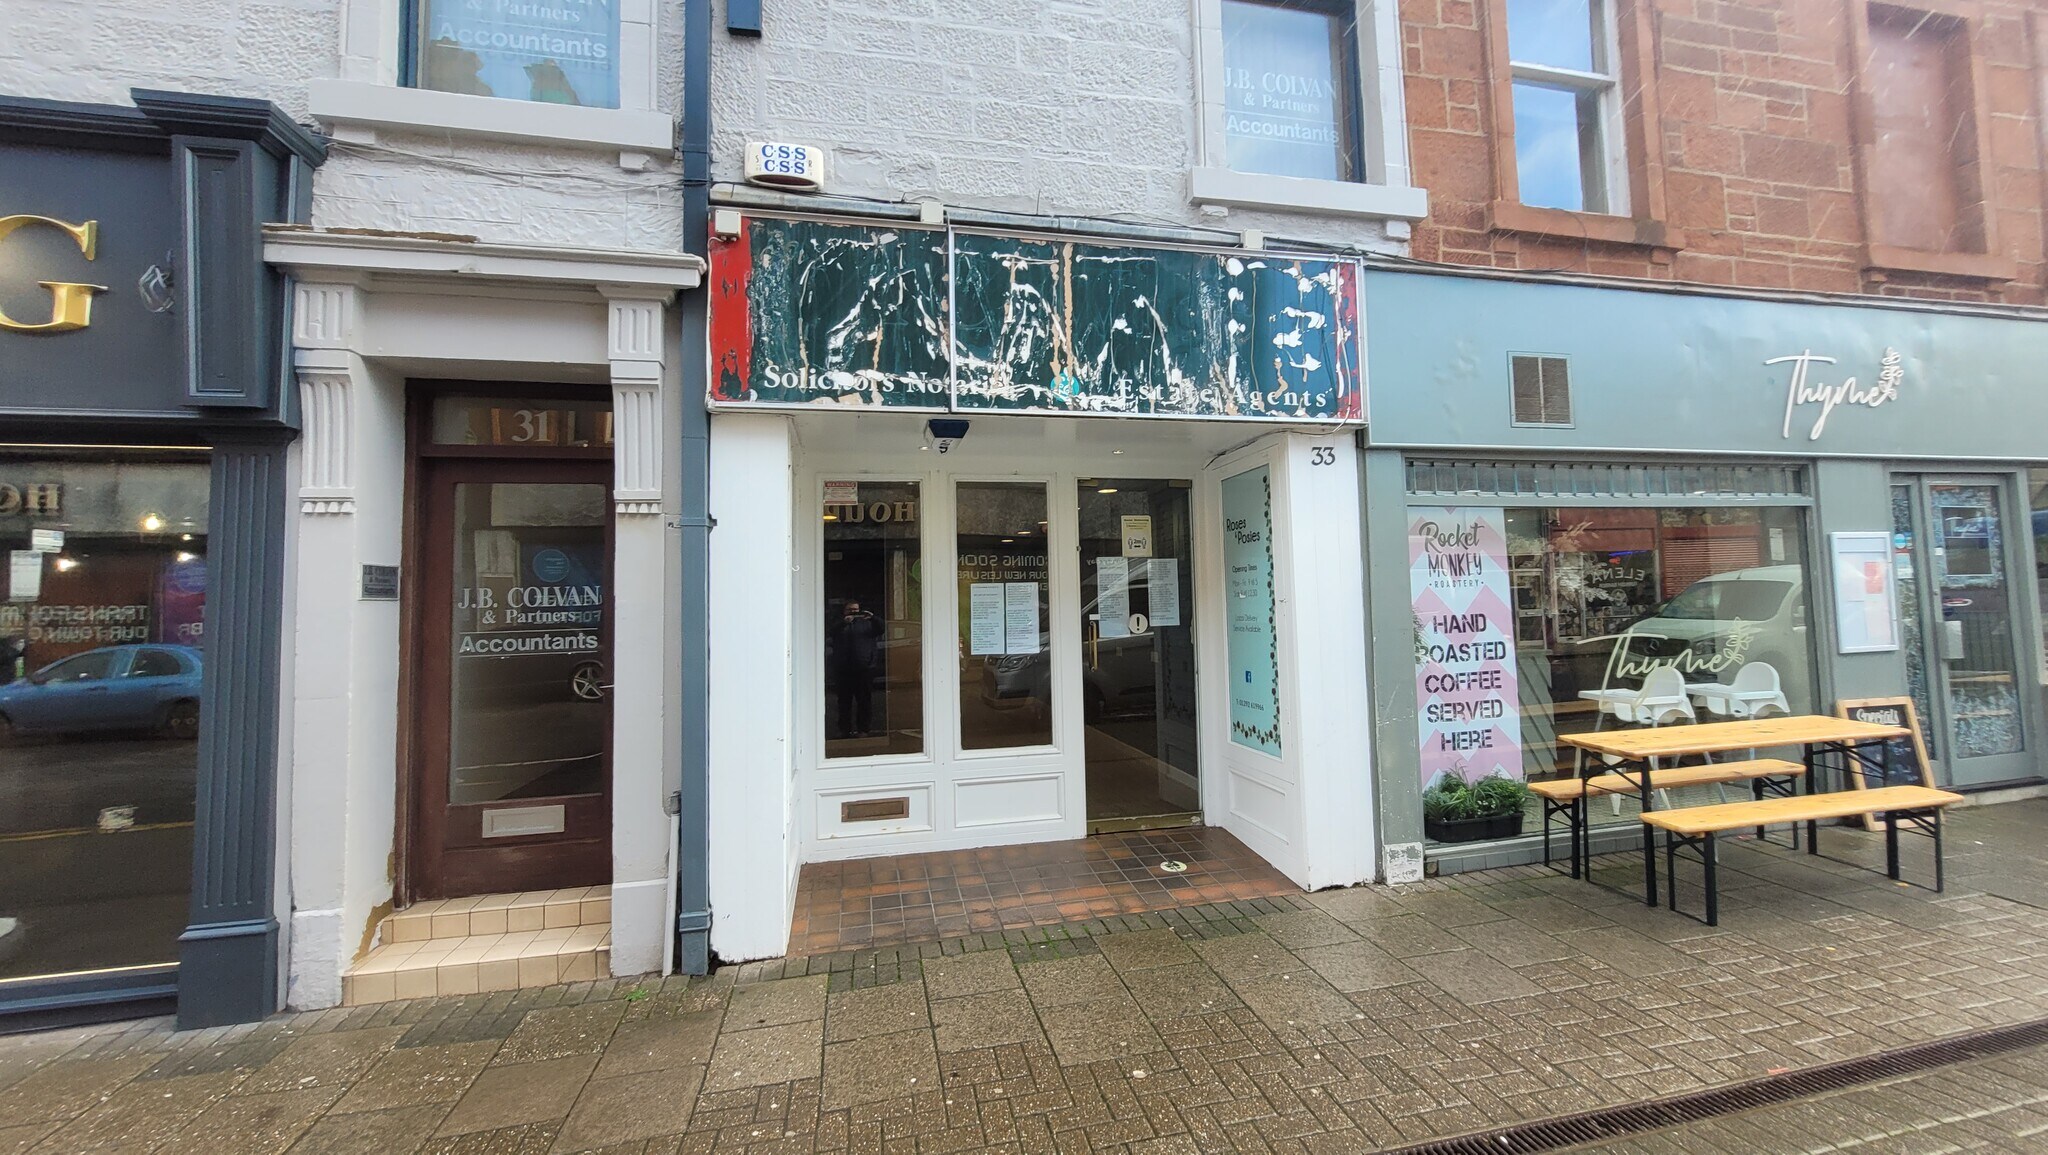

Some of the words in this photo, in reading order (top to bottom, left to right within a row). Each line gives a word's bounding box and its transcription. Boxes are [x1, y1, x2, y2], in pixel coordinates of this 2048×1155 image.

[497, 0, 581, 22] Partners
[432, 22, 607, 59] Accountants
[1224, 67, 1255, 90] J.B.
[1262, 72, 1337, 100] COLVAN
[1244, 92, 1255, 106] &
[1262, 94, 1320, 114] Partners
[1226, 114, 1340, 143] Accountants
[0, 213, 109, 334] G
[764, 365, 895, 392] Solicors
[1232, 383, 1327, 410] Agents
[1763, 349, 1890, 440] Thyme
[511, 410, 551, 442] 31
[1311, 446, 1336, 466] 33
[1226, 519, 1247, 532] Roses
[1419, 521, 1485, 553] Rocket
[1238, 531, 1260, 545] Posies
[1428, 552, 1482, 578] MONKEY
[1434, 580, 1479, 588] ROASTERY
[458, 588, 498, 608] J.B.
[507, 585, 601, 608] COLVAN
[482, 610, 497, 624] &
[505, 609, 576, 624] Partners
[1432, 613, 1486, 634] HAND
[459, 632, 599, 654] Accountants
[1577, 628, 1730, 710] Thyme
[1425, 670, 1502, 693] COFFEE
[1427, 699, 1503, 723] SERVED
[1441, 729, 1493, 751] HERE
